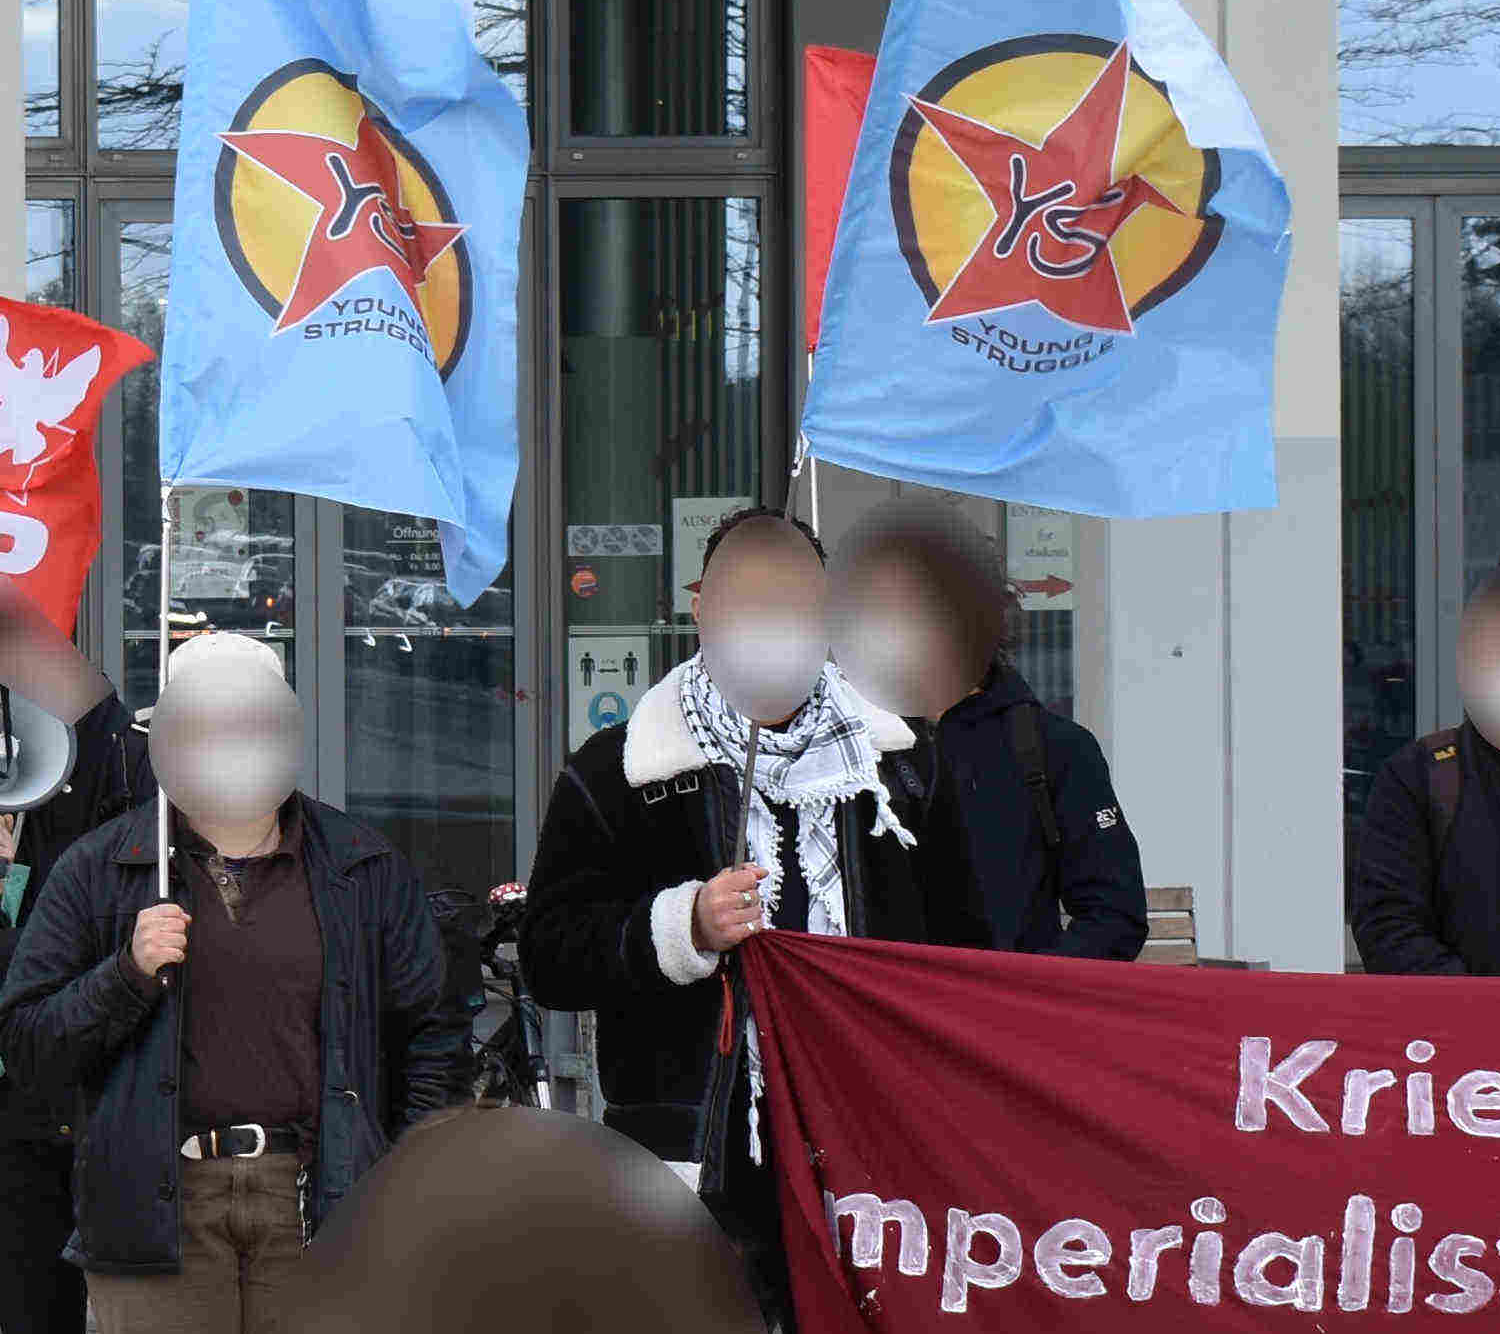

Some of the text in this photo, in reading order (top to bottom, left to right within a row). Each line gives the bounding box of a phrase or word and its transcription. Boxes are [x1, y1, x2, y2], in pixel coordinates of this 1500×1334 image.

[303, 318, 437, 370] STRUGGL
[951, 325, 1116, 373] STRUGGLE
[977, 317, 1094, 355] YOUNG
